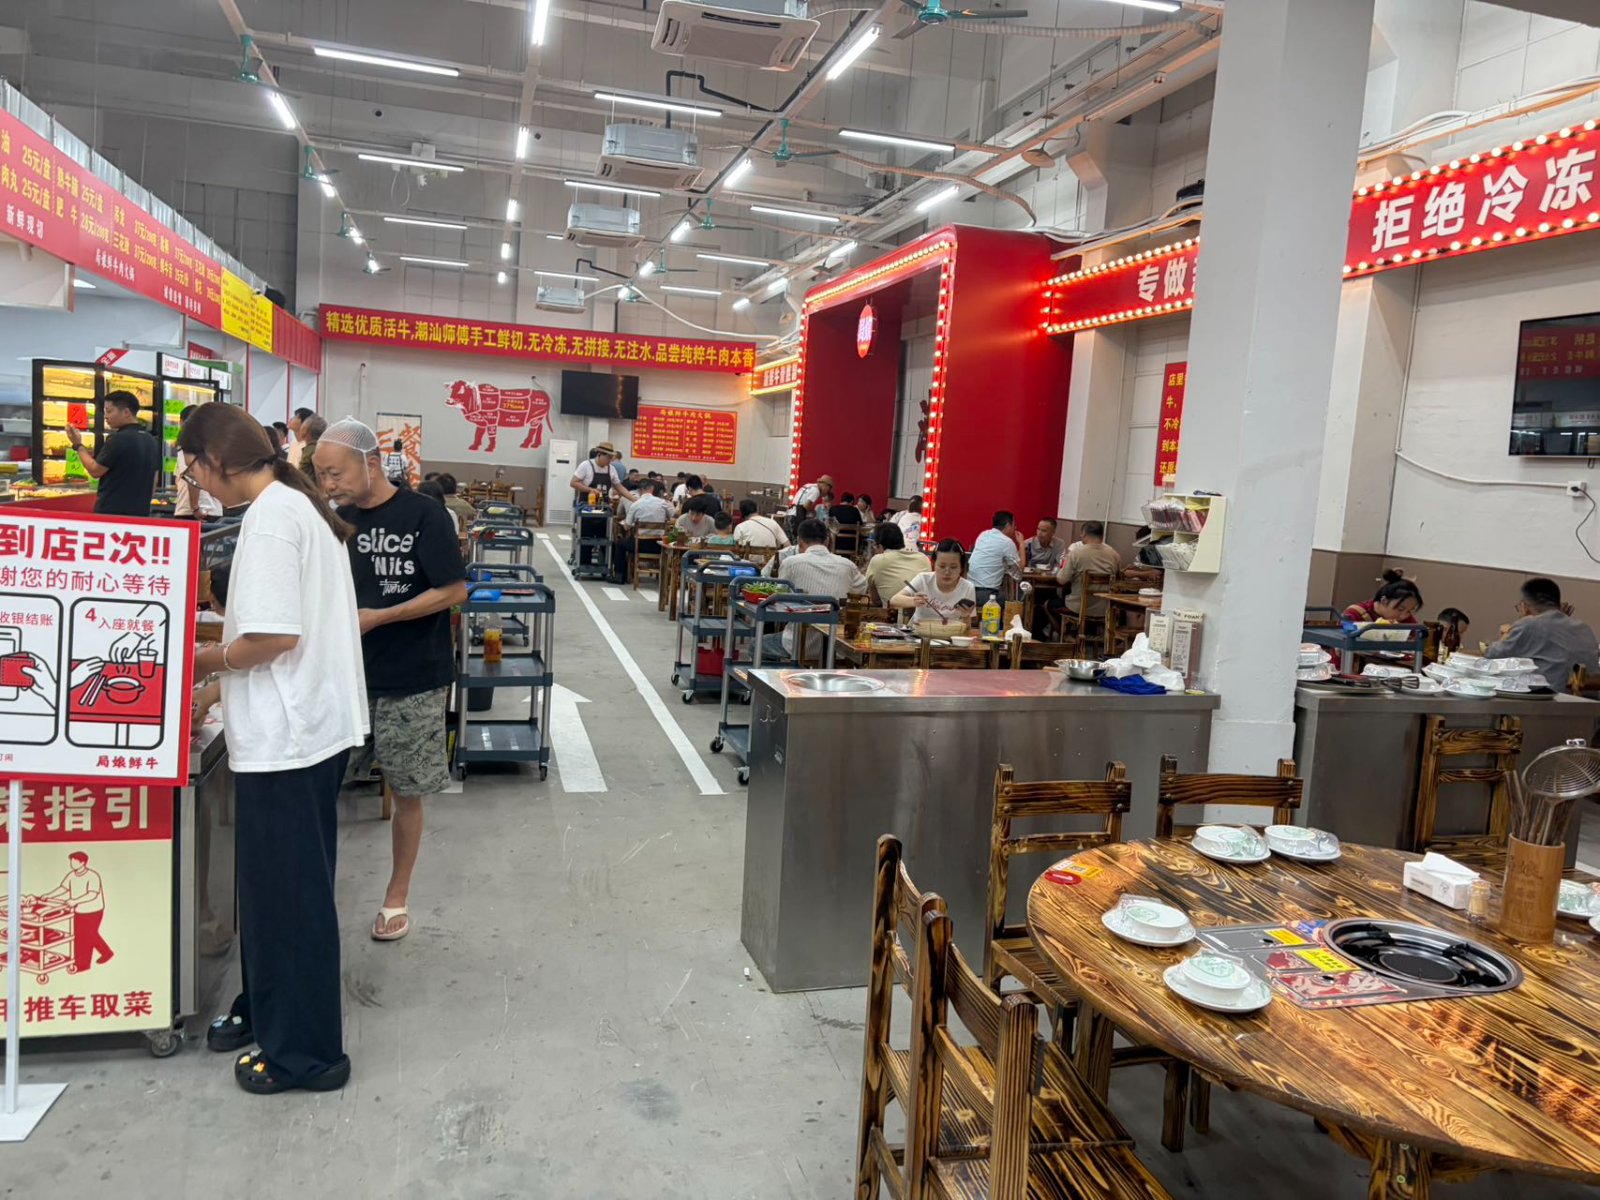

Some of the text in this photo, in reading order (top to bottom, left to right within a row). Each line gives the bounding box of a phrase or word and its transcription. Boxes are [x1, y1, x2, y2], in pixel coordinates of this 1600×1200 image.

[1371, 148, 1596, 252] 拒绝冷冻
[6, 203, 44, 240] 新鲜现切
[1138, 257, 1199, 302] 专做
[0, 612, 54, 626] 收银结账
[85, 607, 97, 622] 4
[98, 618, 155, 632] 入座就餐
